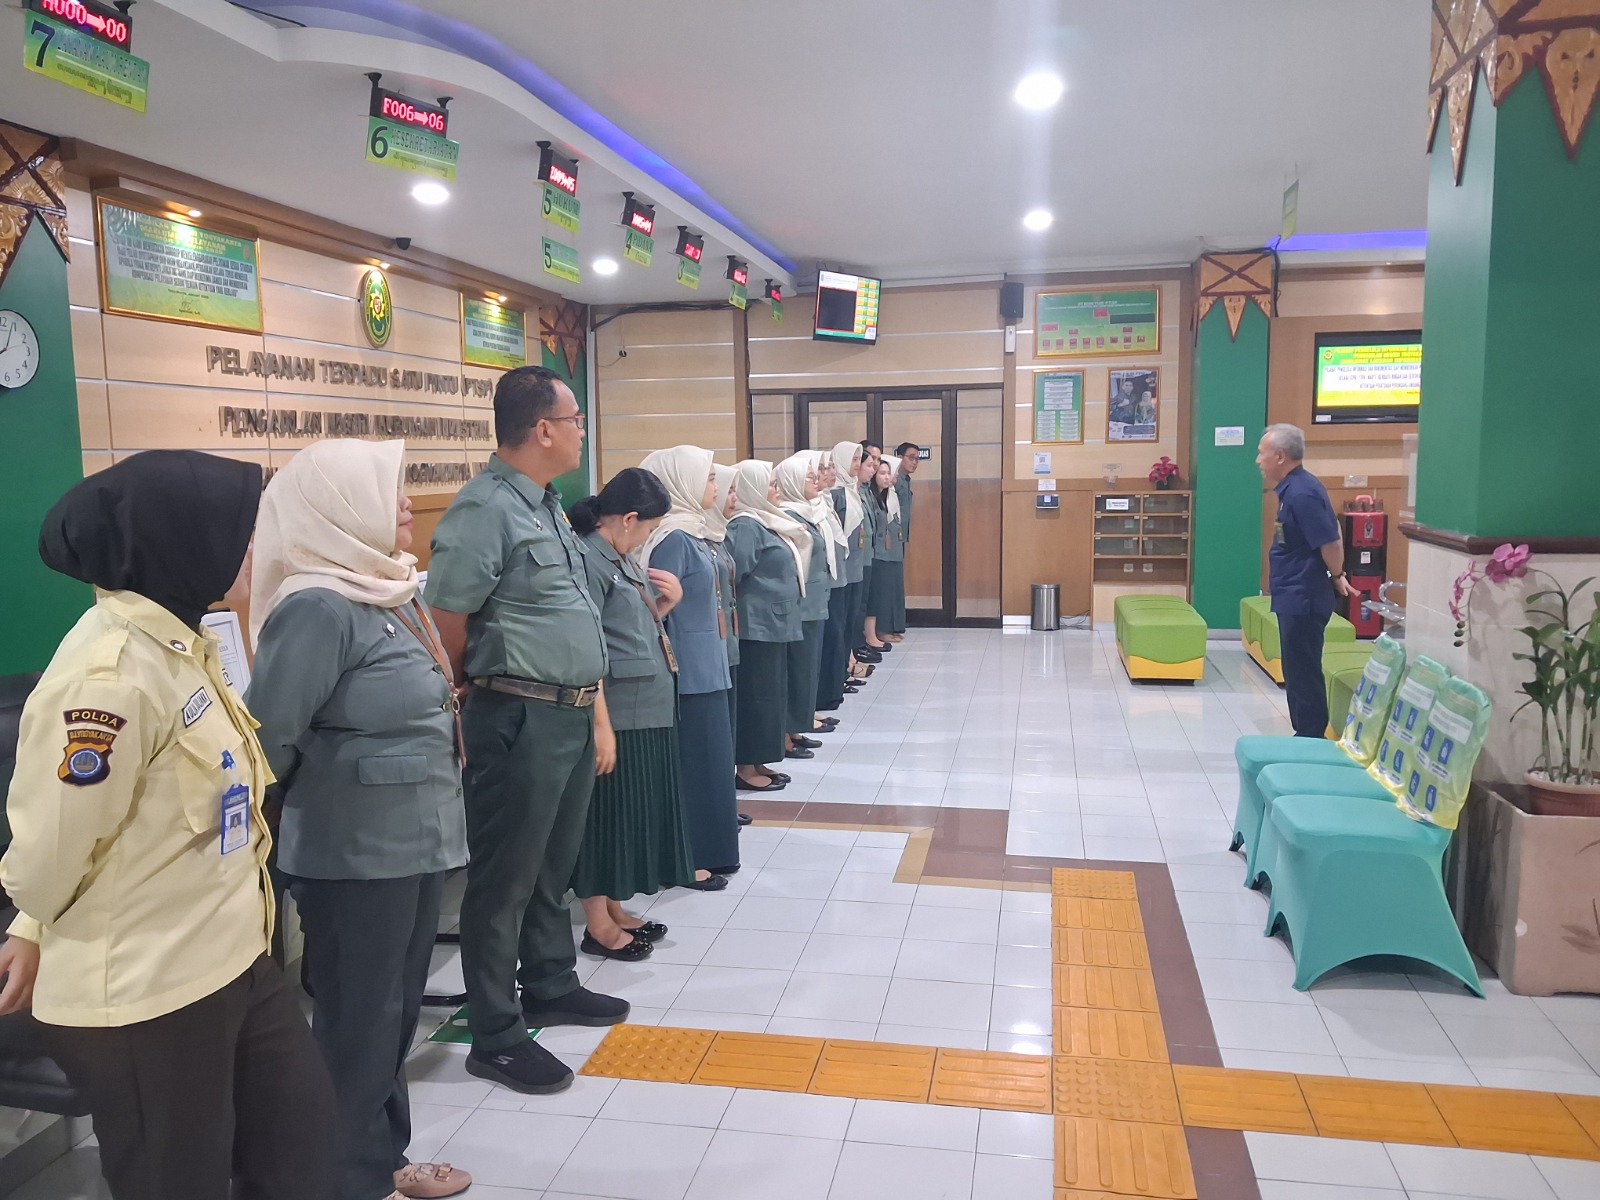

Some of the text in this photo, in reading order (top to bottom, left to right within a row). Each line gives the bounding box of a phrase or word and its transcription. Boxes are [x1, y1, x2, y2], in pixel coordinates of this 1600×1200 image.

[31, 19, 56, 68] 7
[383, 97, 444, 130] F006 06
[370, 126, 389, 159] 6
[544, 188, 552, 215] 5
[545, 242, 552, 269] 5
[21, 333, 27, 344] 2
[26, 346, 31, 357] 3
[4, 372, 11, 382] 6
[15, 368, 21, 379] 5
[22, 360, 28, 369] 4
[205, 345, 315, 382] PELAYANAN
[319, 360, 388, 387] TERPADU
[390, 368, 423, 392] SATU
[424, 373, 459, 395] PINTU
[219, 406, 322, 437] PENGADILAN
[71, 711, 118, 727] POLDA
